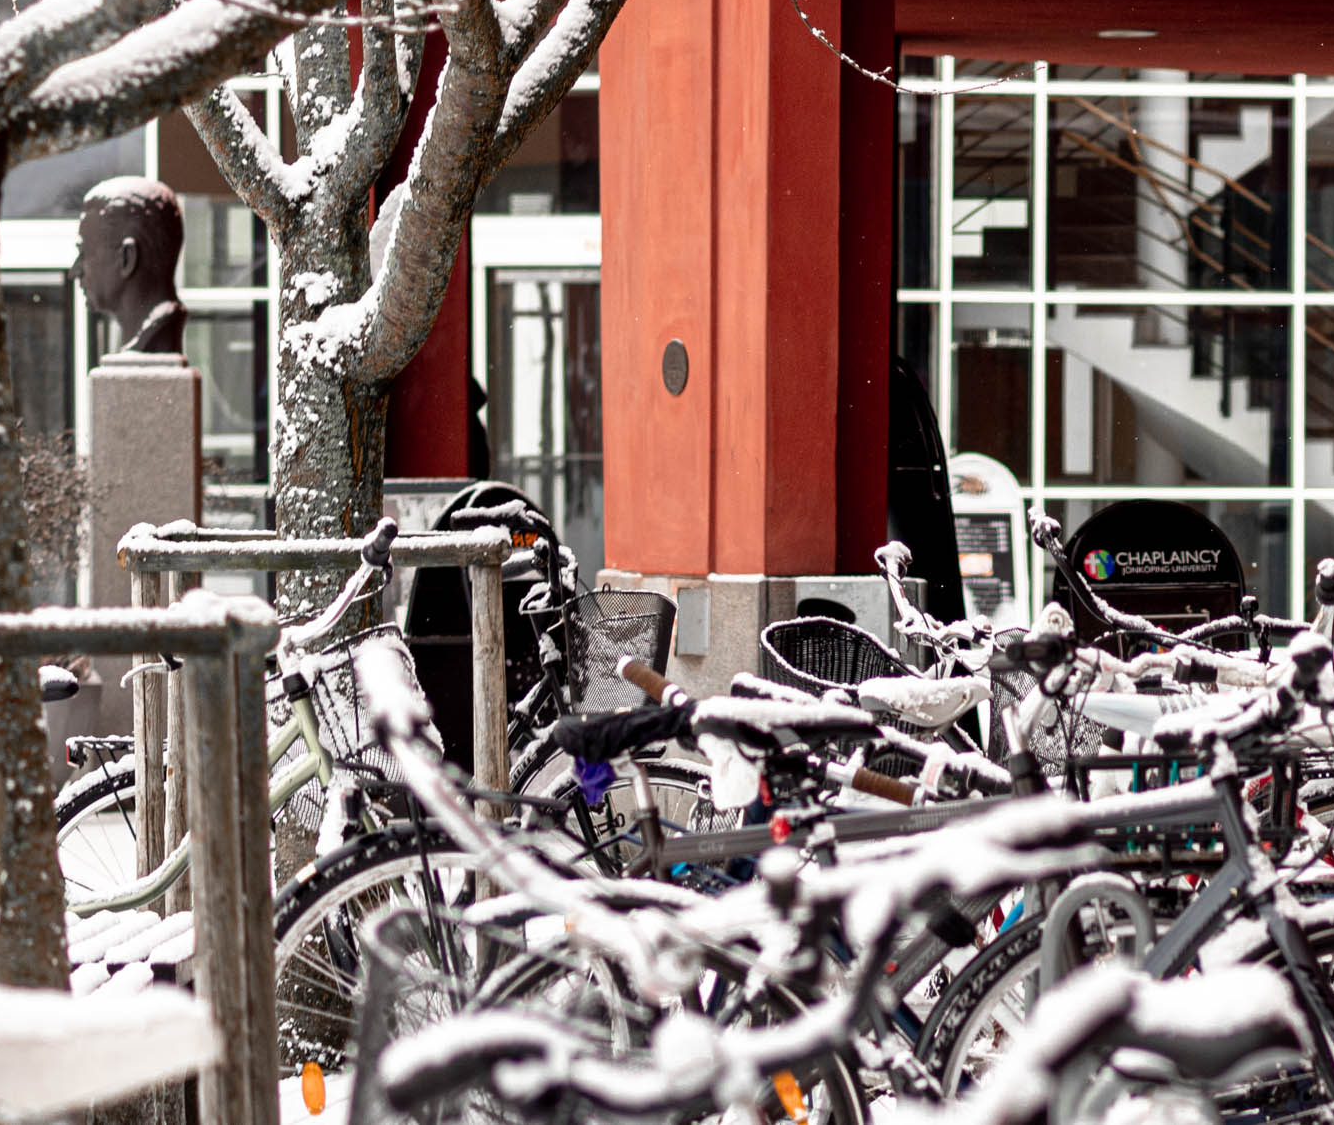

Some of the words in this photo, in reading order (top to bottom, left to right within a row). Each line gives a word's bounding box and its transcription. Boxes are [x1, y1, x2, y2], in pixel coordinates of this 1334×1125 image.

[1115, 549, 1221, 566] CHAPLAINCY
[1172, 564, 1217, 573] UNIVERSITY
[699, 841, 724, 853] City
